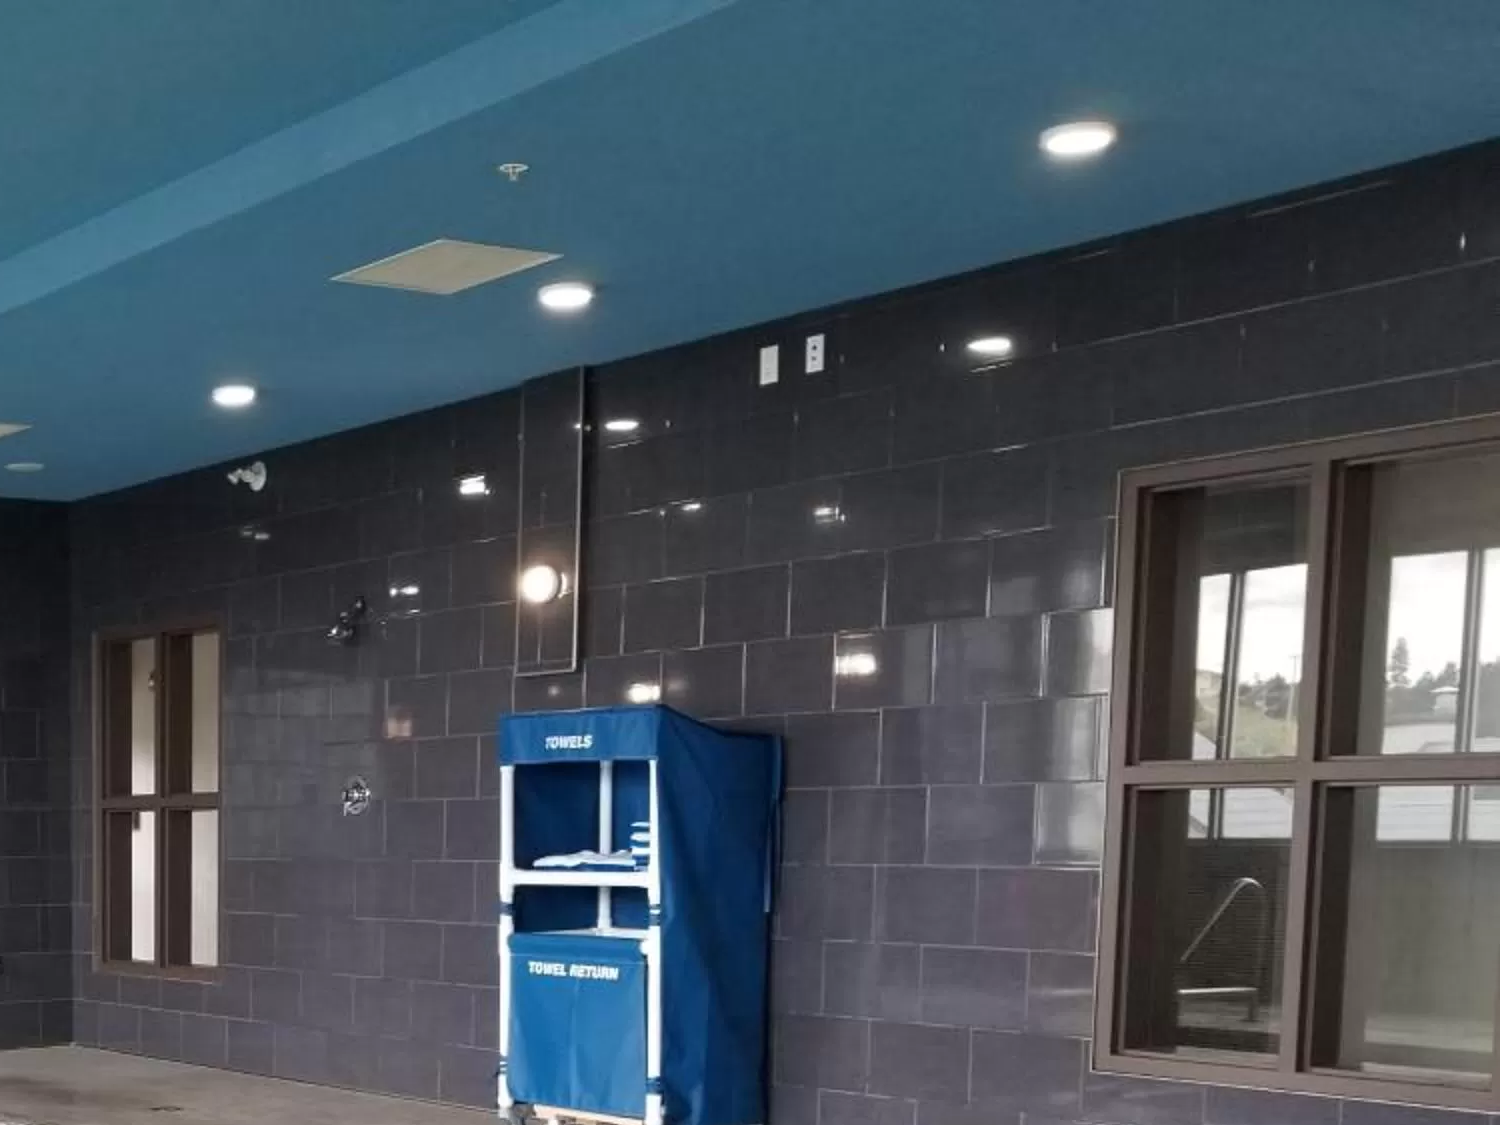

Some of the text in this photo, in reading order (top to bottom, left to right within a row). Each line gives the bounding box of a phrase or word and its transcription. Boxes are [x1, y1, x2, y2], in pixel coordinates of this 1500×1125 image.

[545, 734, 593, 750] TOWELS
[528, 960, 619, 981] TOWEL RETURN
